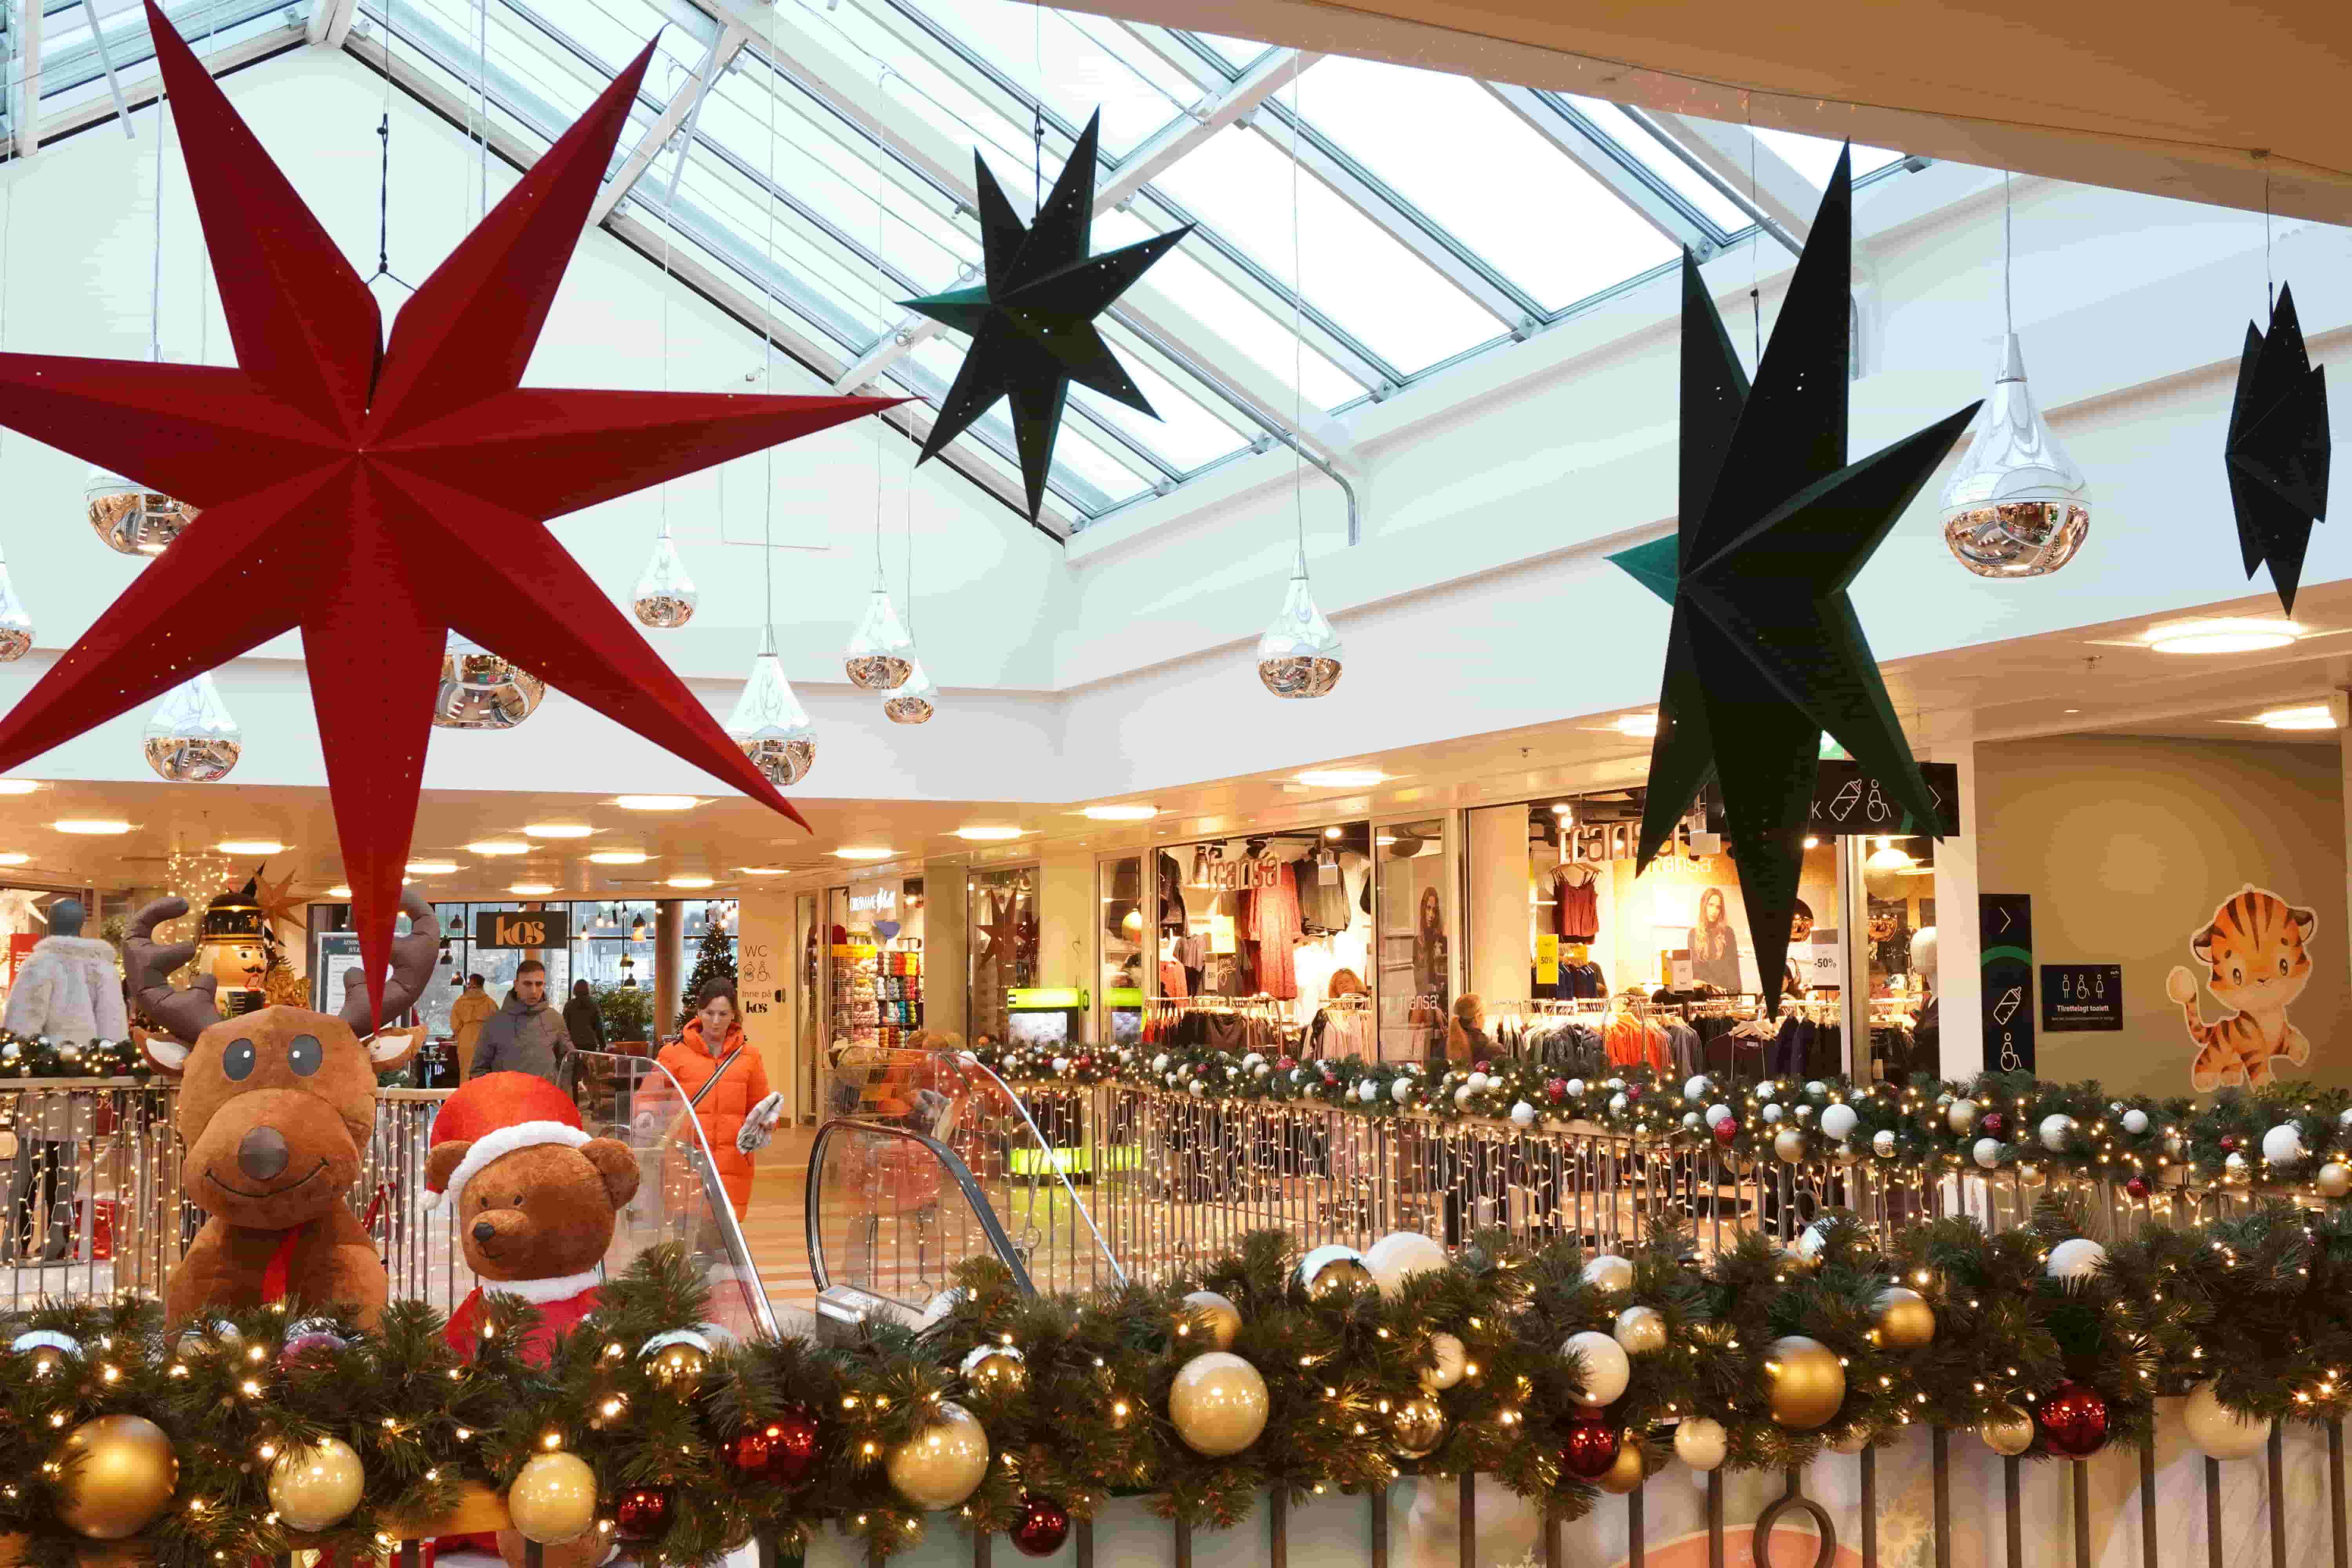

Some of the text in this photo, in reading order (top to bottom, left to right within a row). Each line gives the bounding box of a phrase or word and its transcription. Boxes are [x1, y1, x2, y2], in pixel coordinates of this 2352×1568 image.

[496, 916, 545, 946] kos
[744, 945, 768, 957] WC
[1814, 958, 1837, 968] -50%
[762, 988, 772, 999] på
[746, 1000, 768, 1013] kos
